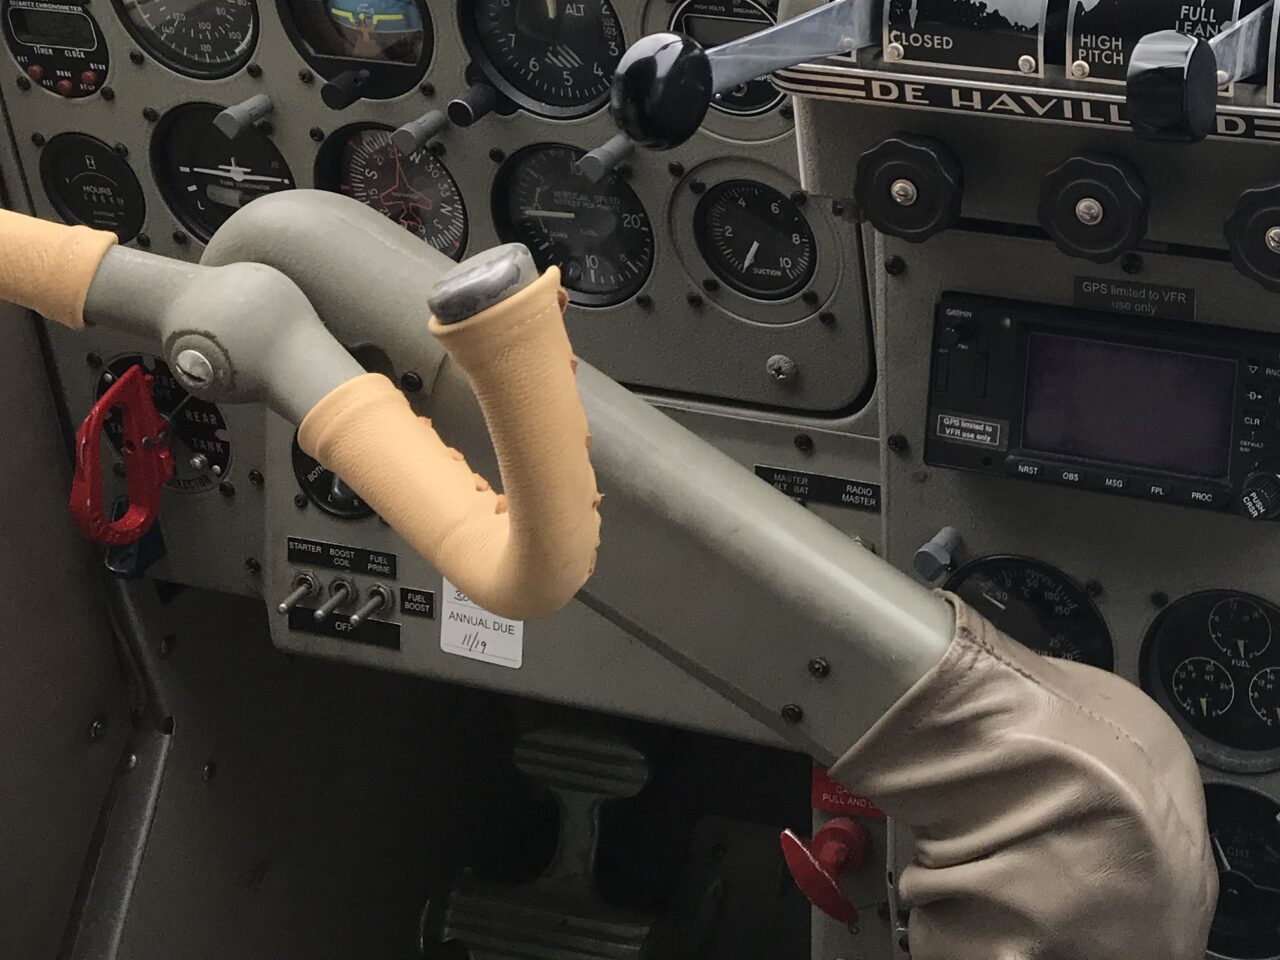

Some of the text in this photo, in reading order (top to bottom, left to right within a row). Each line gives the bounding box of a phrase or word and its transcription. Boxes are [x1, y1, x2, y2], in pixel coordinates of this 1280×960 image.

[565, 3, 585, 16] ALT
[1180, 5, 1217, 23] FULL
[890, 30, 954, 52] CLOSED
[1080, 35, 1123, 51] HIGH
[1078, 49, 1124, 67] PITCH
[872, 80, 1247, 137] DE HAVILLD
[1082, 281, 1186, 304] GPS limited to VFR
[1111, 300, 1157, 315] use only
[847, 485, 872, 495] RADIO
[842, 494, 876, 506] MASTER
[289, 541, 322, 554] STARTER
[329, 548, 355, 559] BOOST
[369, 555, 388, 565] FUEL
[367, 563, 391, 574] PRIME
[408, 594, 426, 603] FUEL
[405, 601, 430, 612] BOOST
[449, 611, 515, 635] ANNUAL DUE
[461, 633, 487, 653] 11/19
